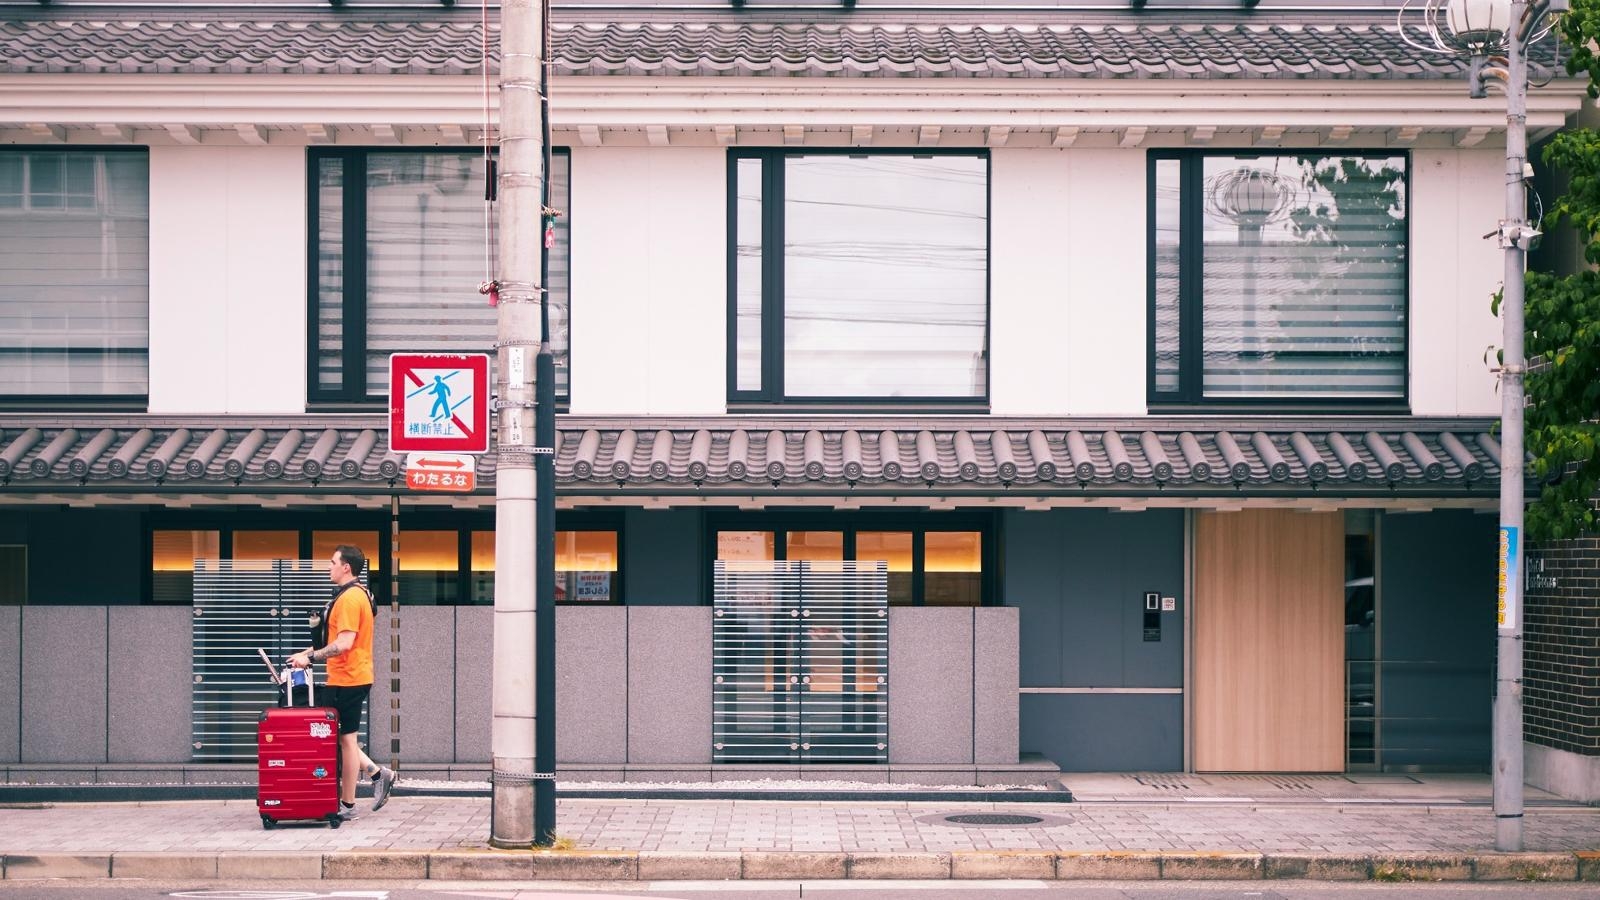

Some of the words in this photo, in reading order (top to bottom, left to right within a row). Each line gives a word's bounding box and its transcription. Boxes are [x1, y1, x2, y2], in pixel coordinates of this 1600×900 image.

[409, 422, 455, 435] 横断禁止
[412, 472, 467, 486] わたるな
